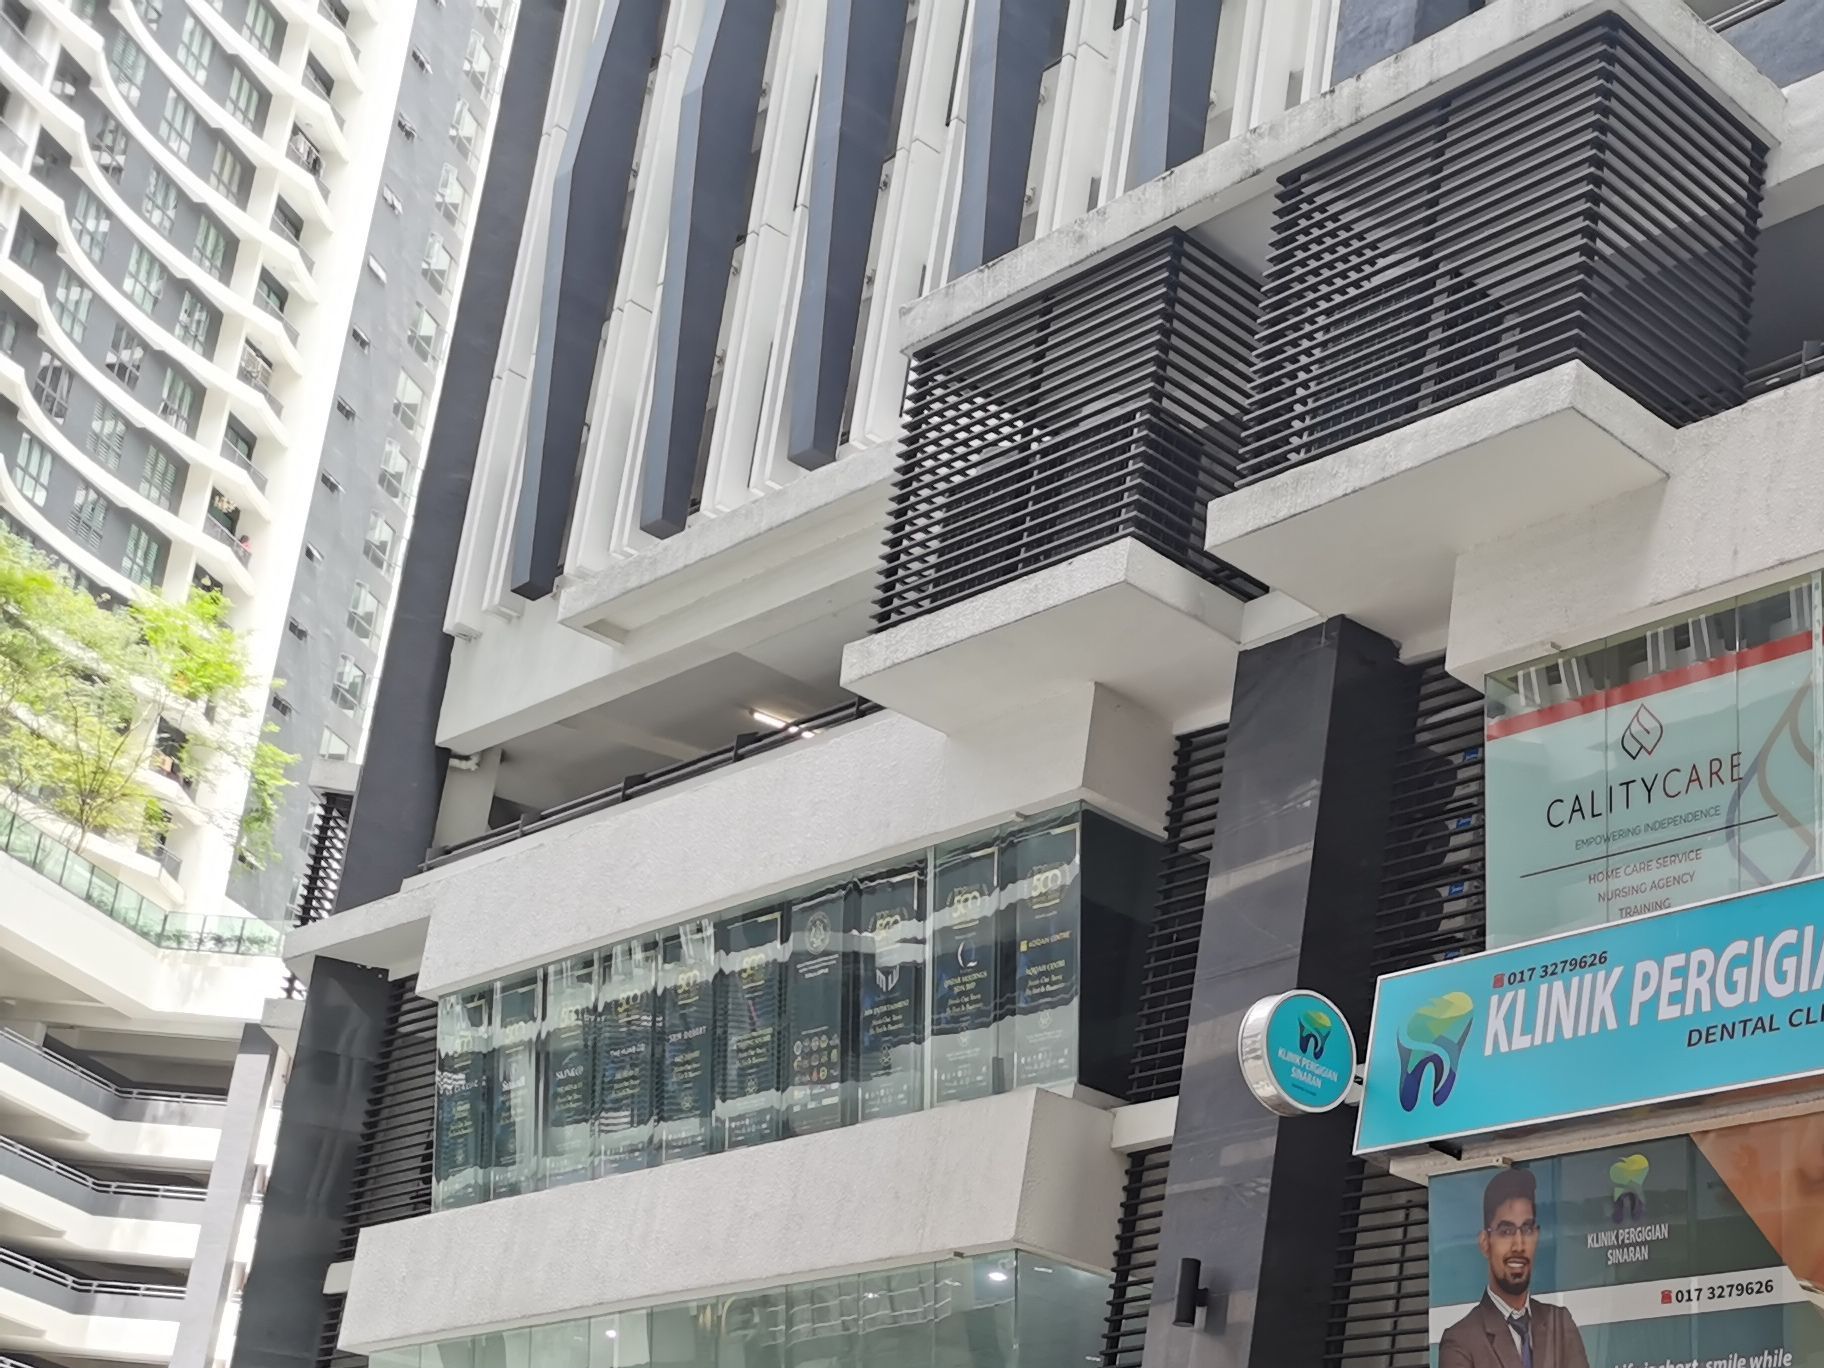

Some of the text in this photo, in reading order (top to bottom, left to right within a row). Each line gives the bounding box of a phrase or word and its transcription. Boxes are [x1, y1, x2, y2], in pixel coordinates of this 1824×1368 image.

[1546, 752, 1743, 828] CALITYCARE
[1574, 805, 1721, 851] EMPOWERING INDEPENDENCE
[1588, 848, 1703, 885] HOME CARE SERVICE
[1597, 870, 1696, 903] NURSING AGENCY
[1618, 898, 1672, 919] TRAINING
[1507, 951, 1608, 986] 017 3279626
[1484, 966, 1624, 1056] KLINIK
[1686, 1013, 1780, 1048] DENTAL
[1587, 1223, 1669, 1248] KLINIK PERGIGIAN
[1607, 1245, 1649, 1265] SINARAN
[1675, 1279, 1774, 1303] 017 3279626
